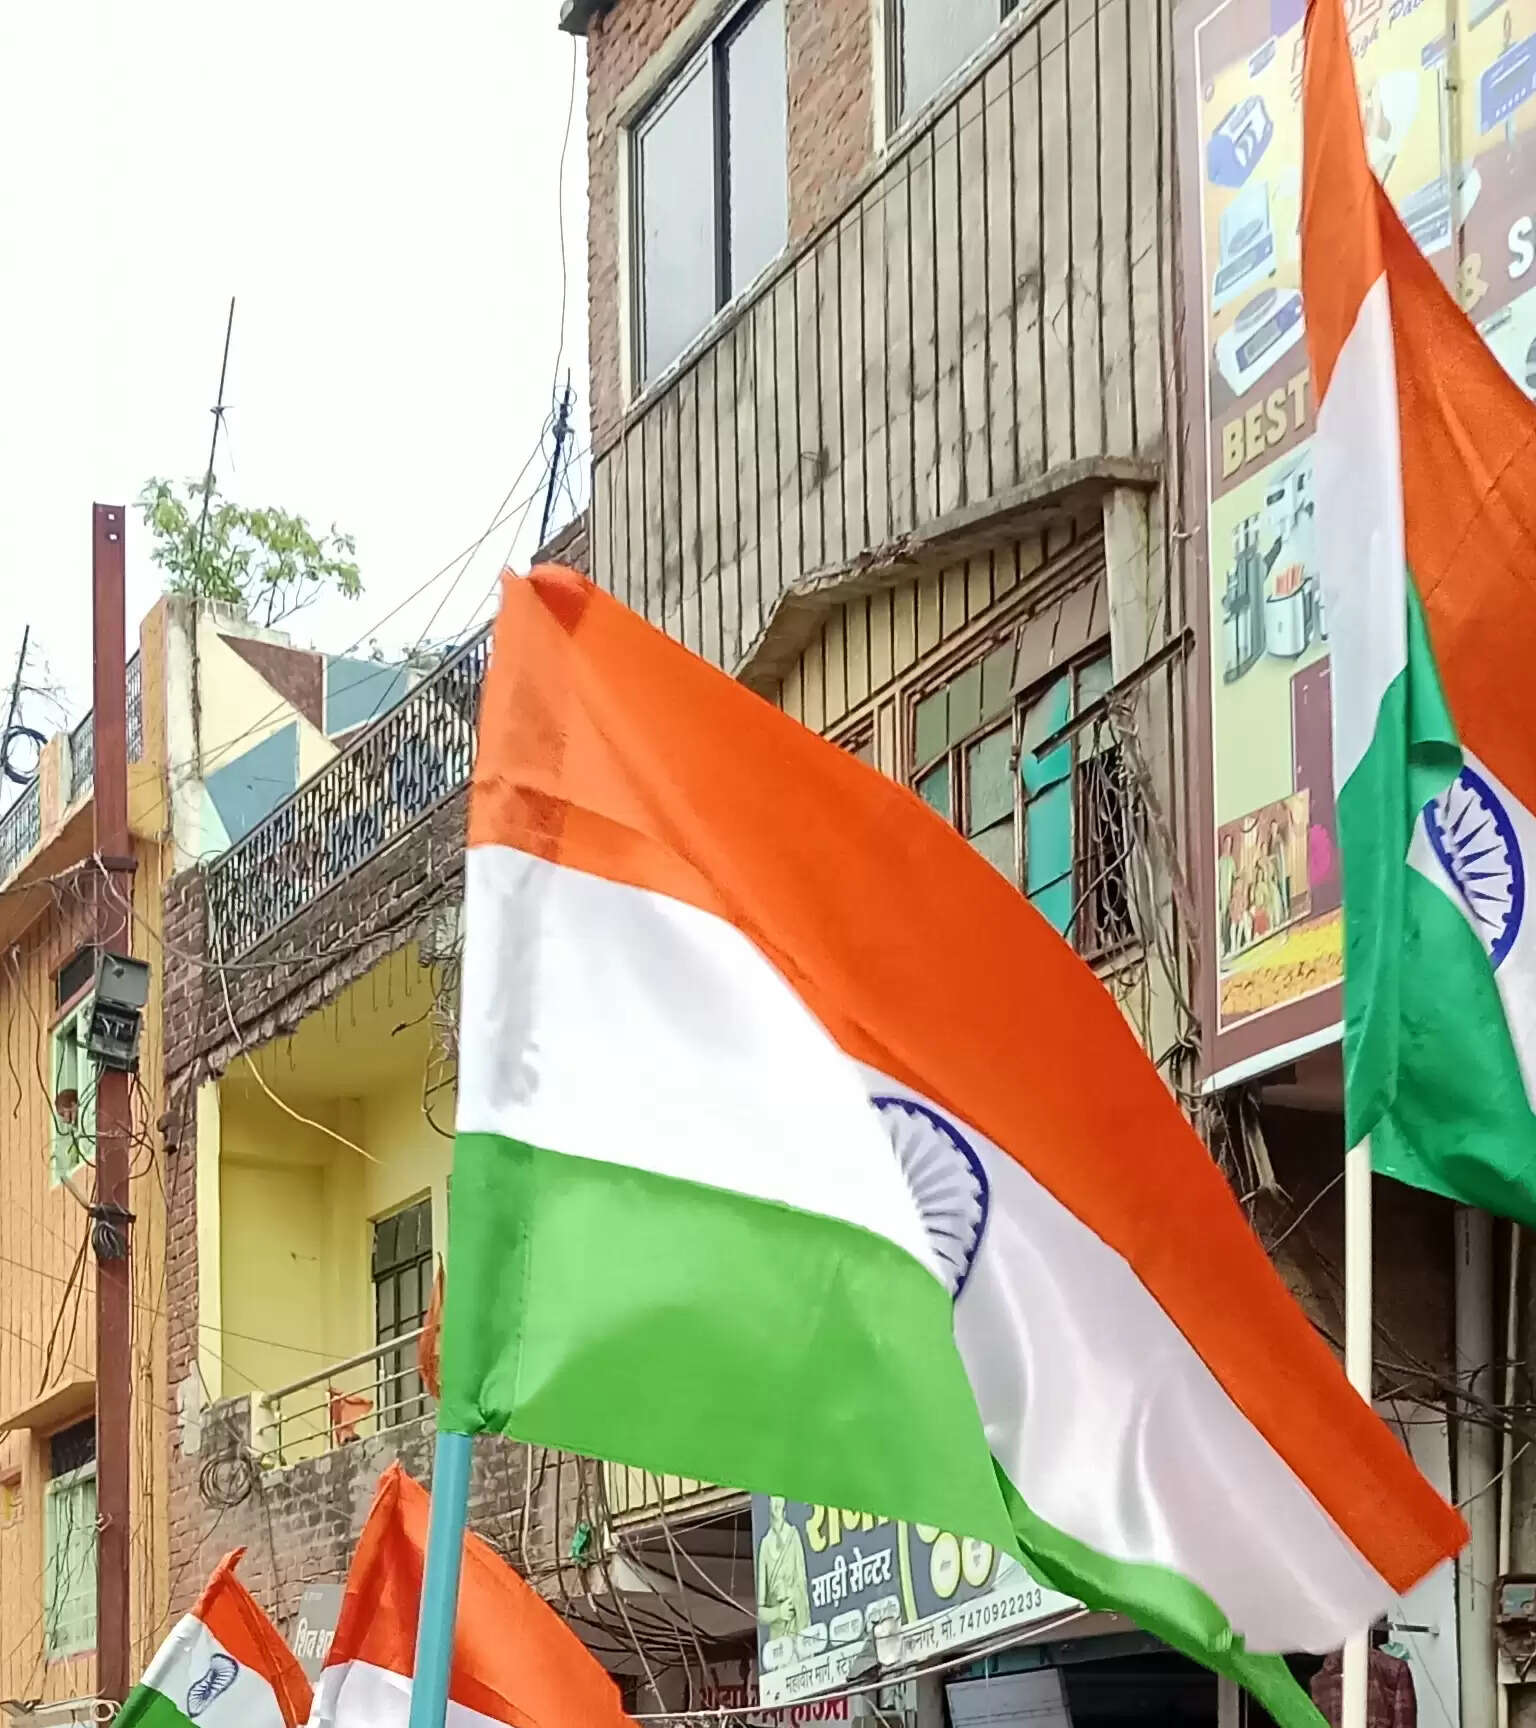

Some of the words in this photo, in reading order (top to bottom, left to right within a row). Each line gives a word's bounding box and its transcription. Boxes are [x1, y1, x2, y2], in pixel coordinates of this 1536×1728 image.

[1222, 368, 1309, 480] BEST
[811, 1555, 848, 1608] साड़ी
[959, 1588, 1042, 1633] 7470922233
